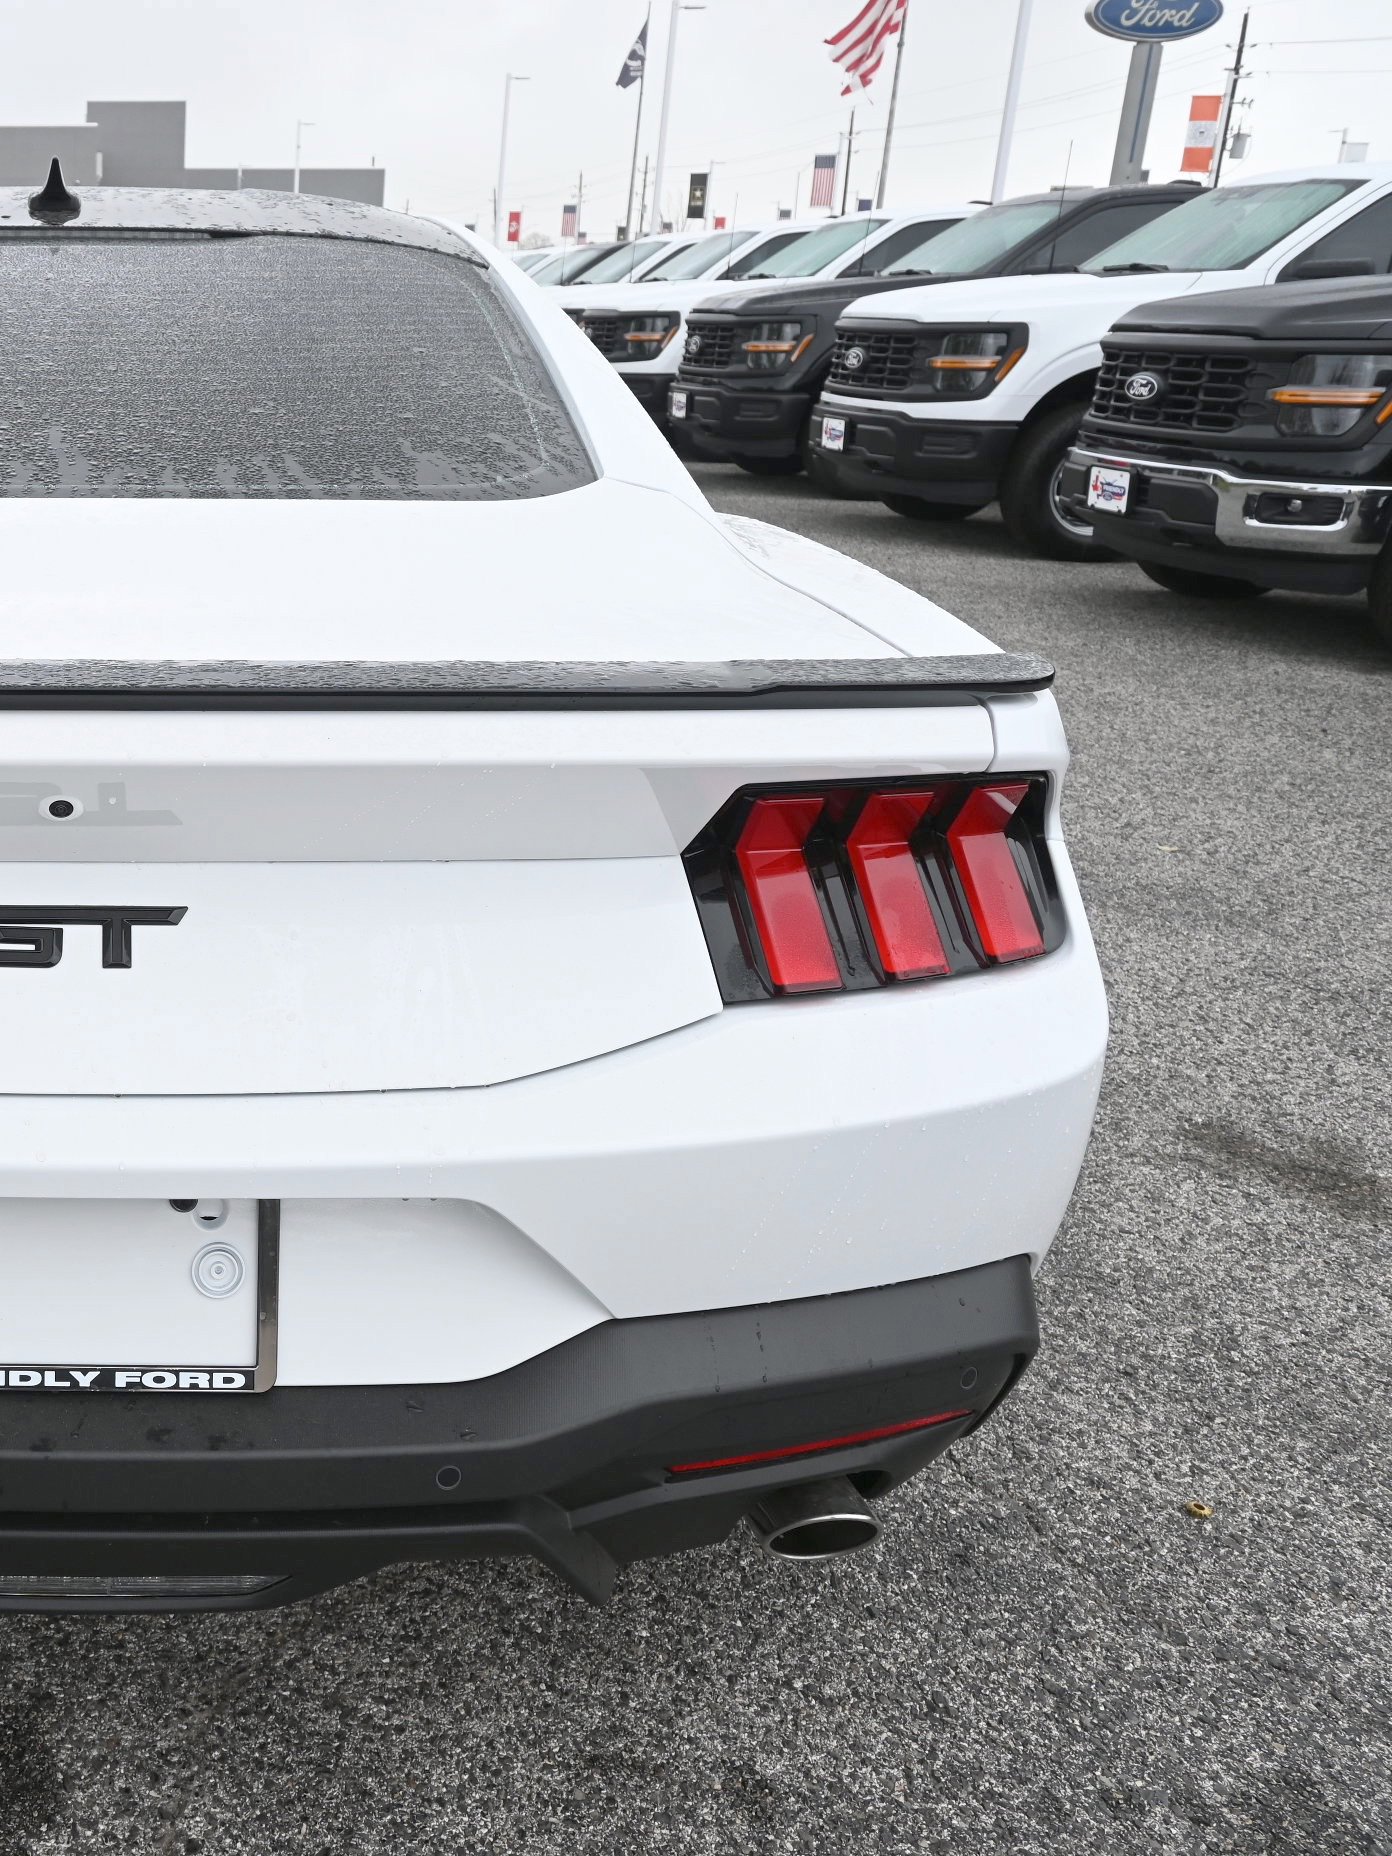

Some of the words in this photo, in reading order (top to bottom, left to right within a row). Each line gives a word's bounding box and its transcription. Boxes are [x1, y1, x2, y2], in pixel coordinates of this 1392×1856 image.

[1120, 0, 1199, 27] Ford
[1129, 378, 1152, 396] Ford
[114, 1370, 247, 1389] FORD
